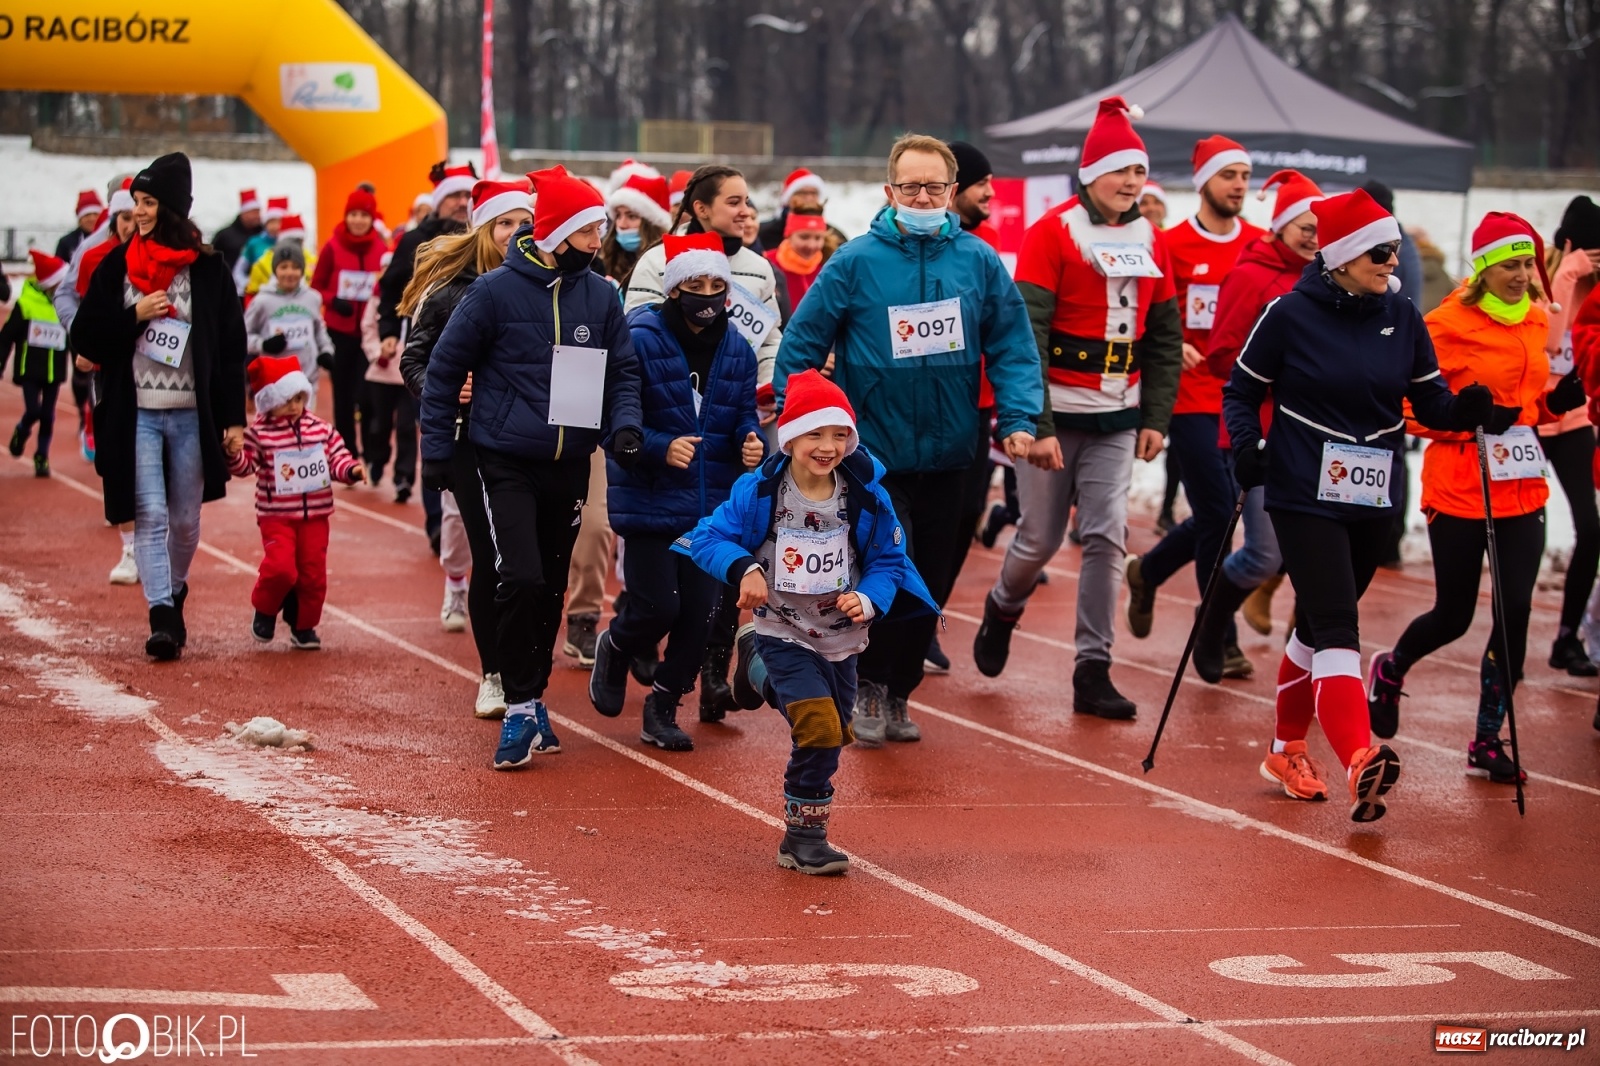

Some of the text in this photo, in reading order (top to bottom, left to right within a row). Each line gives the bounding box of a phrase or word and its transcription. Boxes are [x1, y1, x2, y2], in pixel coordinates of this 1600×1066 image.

[25, 11, 190, 44] RACIBÓRZ
[1117, 254, 1145, 266] 157
[732, 303, 765, 335] 090
[917, 316, 956, 338] 097
[145, 327, 180, 351] 089
[1511, 444, 1542, 462] 051
[297, 459, 327, 479] 086
[1350, 466, 1386, 489] 050
[806, 547, 844, 575] 054
